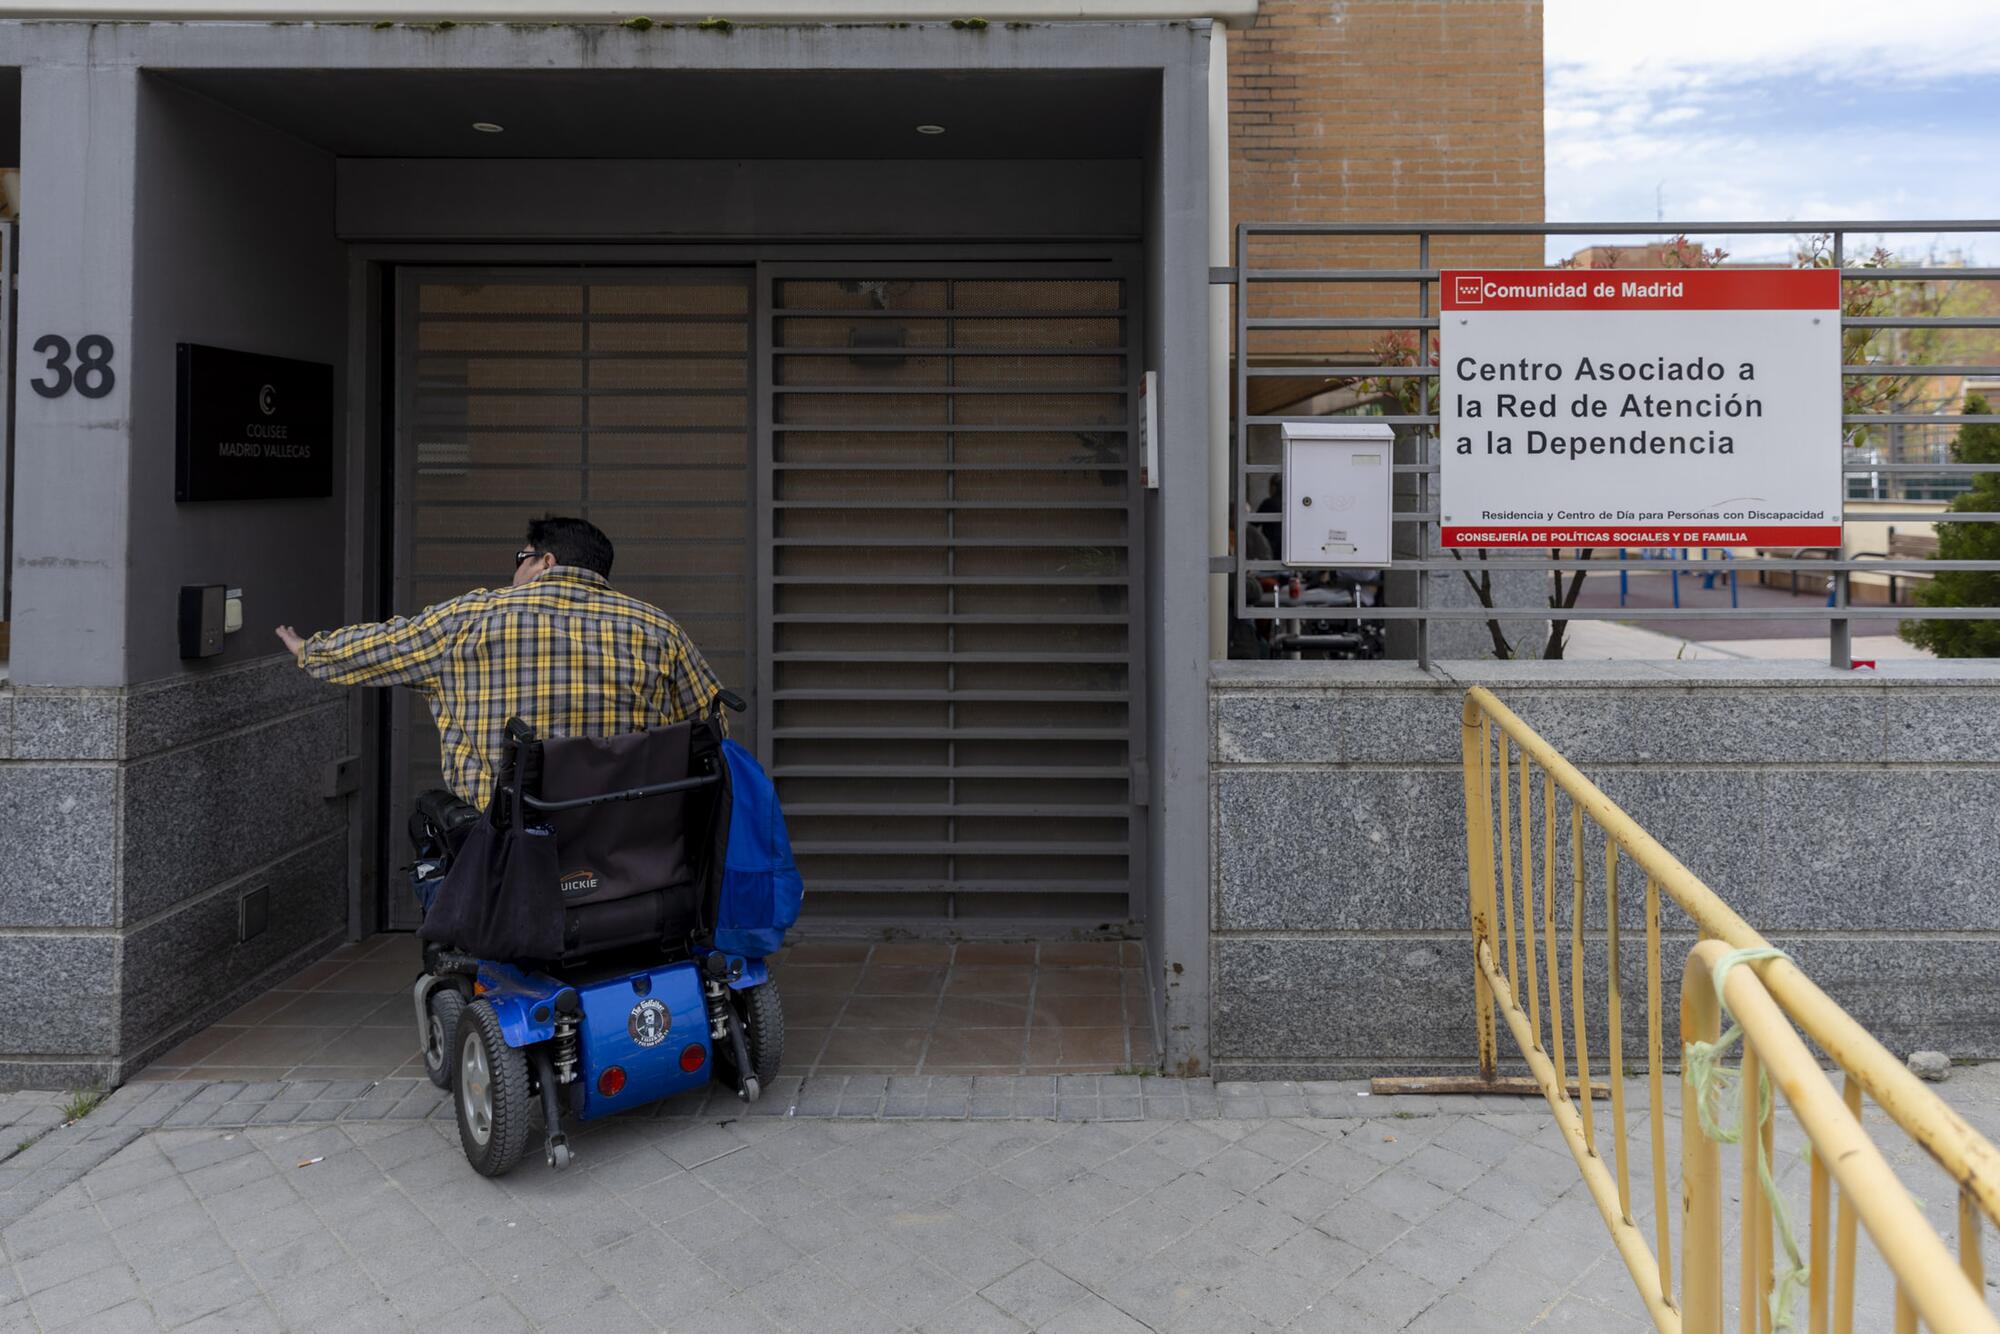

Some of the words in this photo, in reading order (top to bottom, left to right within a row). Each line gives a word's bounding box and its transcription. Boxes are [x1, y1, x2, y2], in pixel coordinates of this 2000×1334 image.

[1483, 281, 1588, 298] Comunidad
[1593, 281, 1616, 298] de
[1621, 281, 1684, 298] Madrid
[30, 334, 116, 399] 38
[1456, 356, 1563, 382] Centro
[1574, 356, 1725, 382] Asociado
[1738, 362, 1755, 382] a
[1457, 393, 1483, 418] la
[1497, 393, 1557, 418] Red
[1570, 393, 1608, 418] de
[1619, 392, 1763, 418] Atención
[246, 423, 288, 439] COLISEE
[218, 442, 261, 457] MADRID
[263, 444, 311, 458] VALLECAS
[1456, 436, 1473, 455] a
[1487, 430, 1513, 455] la
[1527, 430, 1735, 460] Dependencia
[1481, 510, 1544, 520] Residencia
[1547, 512, 1554, 522] y
[1557, 510, 1596, 520] Centro
[1598, 510, 1613, 520] de
[1616, 510, 1635, 520] Día
[1638, 512, 1664, 522] para
[1667, 510, 1720, 520] Personas
[1723, 512, 1745, 520] con
[1747, 510, 1824, 521] Discapacidad
[1456, 531, 1529, 542] CONSEJERÍA
[1531, 532, 1547, 542] DE
[1550, 531, 1610, 542] POLÍTICAS
[1613, 532, 1670, 542] SOCIALES
[1672, 532, 1681, 542] Y
[1683, 532, 1699, 542] DE
[1702, 532, 1748, 542] FAMILIA
[560, 878, 598, 892] UICKIE
